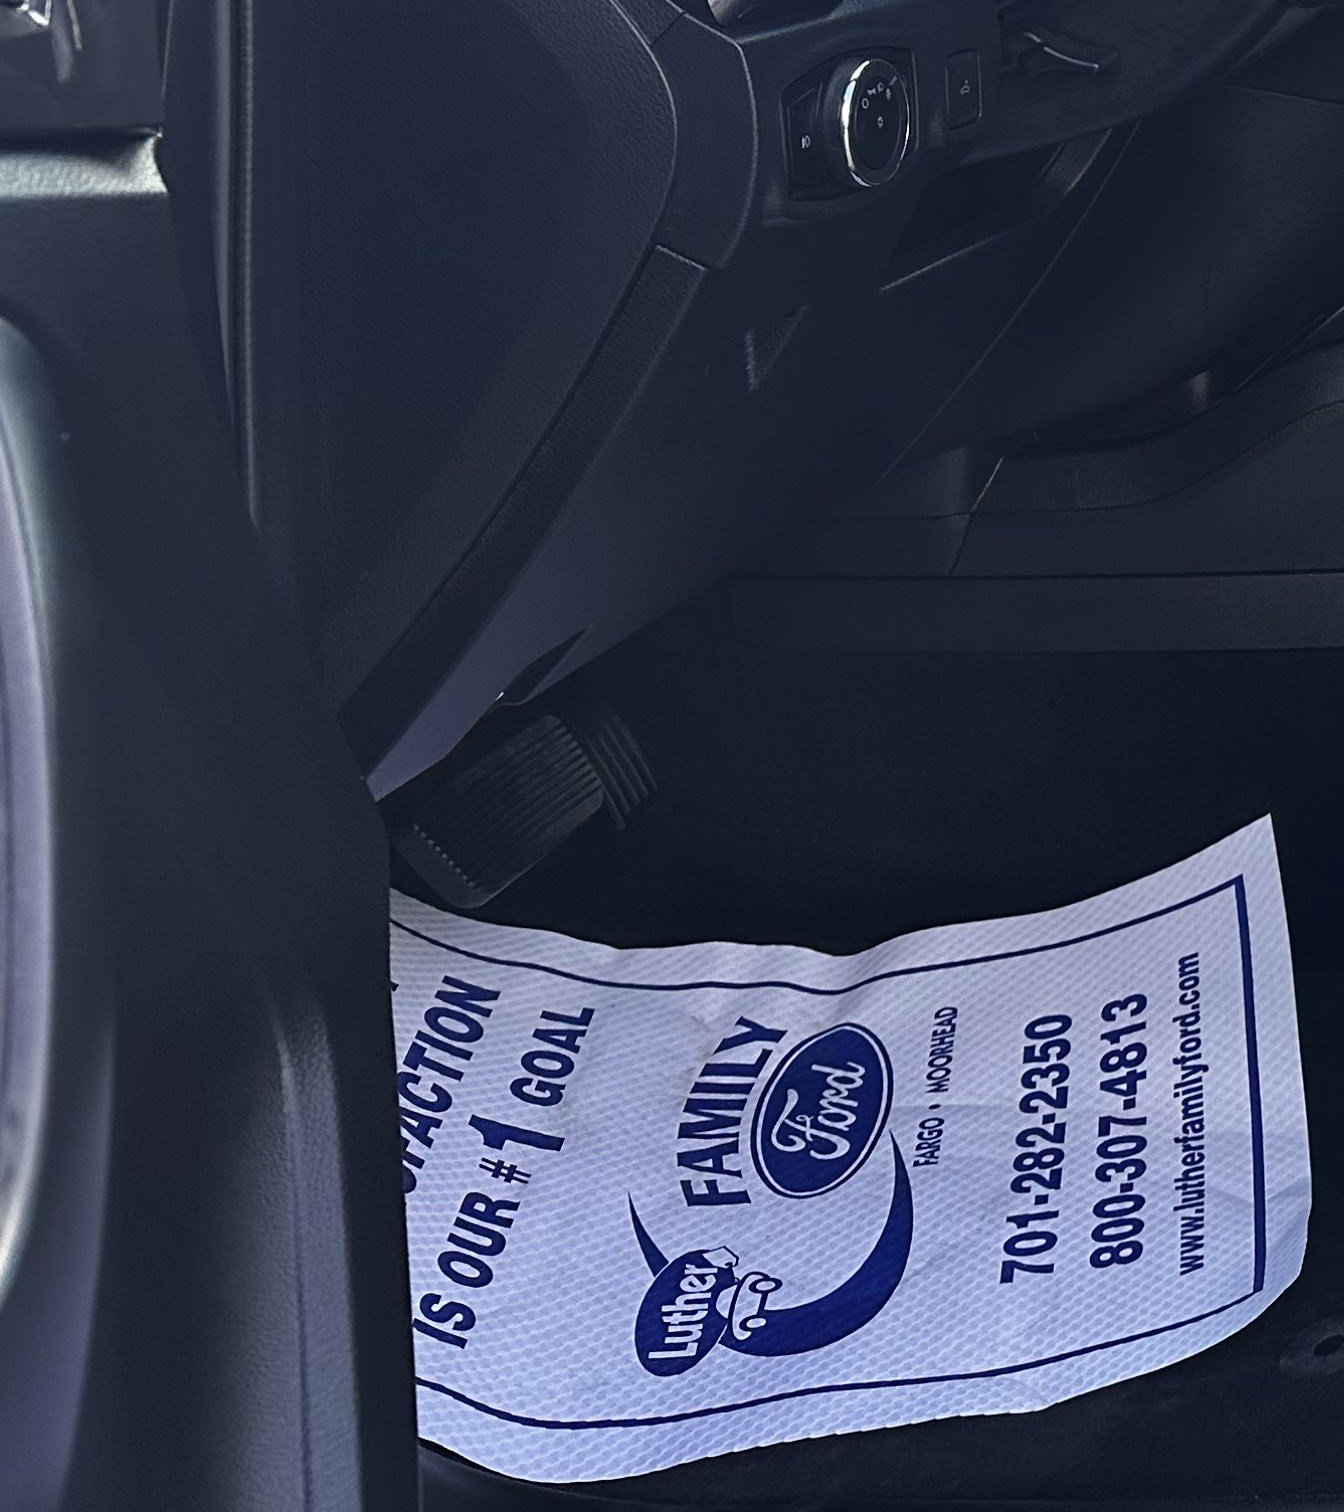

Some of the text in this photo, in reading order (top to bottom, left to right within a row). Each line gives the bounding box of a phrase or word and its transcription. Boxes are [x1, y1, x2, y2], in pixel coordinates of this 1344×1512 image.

[397, 975, 501, 1193] ACTION
[509, 1007, 595, 1107] GOAL
[676, 1016, 788, 1207] FAMILY
[770, 1061, 866, 1160] Ford
[912, 1006, 958, 1168] FARGO MOORHEAD
[1089, 993, 1148, 1270] 800-307-4813
[1173, 951, 1209, 1276] www.lutherfamilyford.com
[999, 1014, 1073, 1284] 701-282-2350
[412, 1292, 477, 1349] IS
[437, 1191, 521, 1288] OUR
[648, 1263, 719, 1360] Luther
